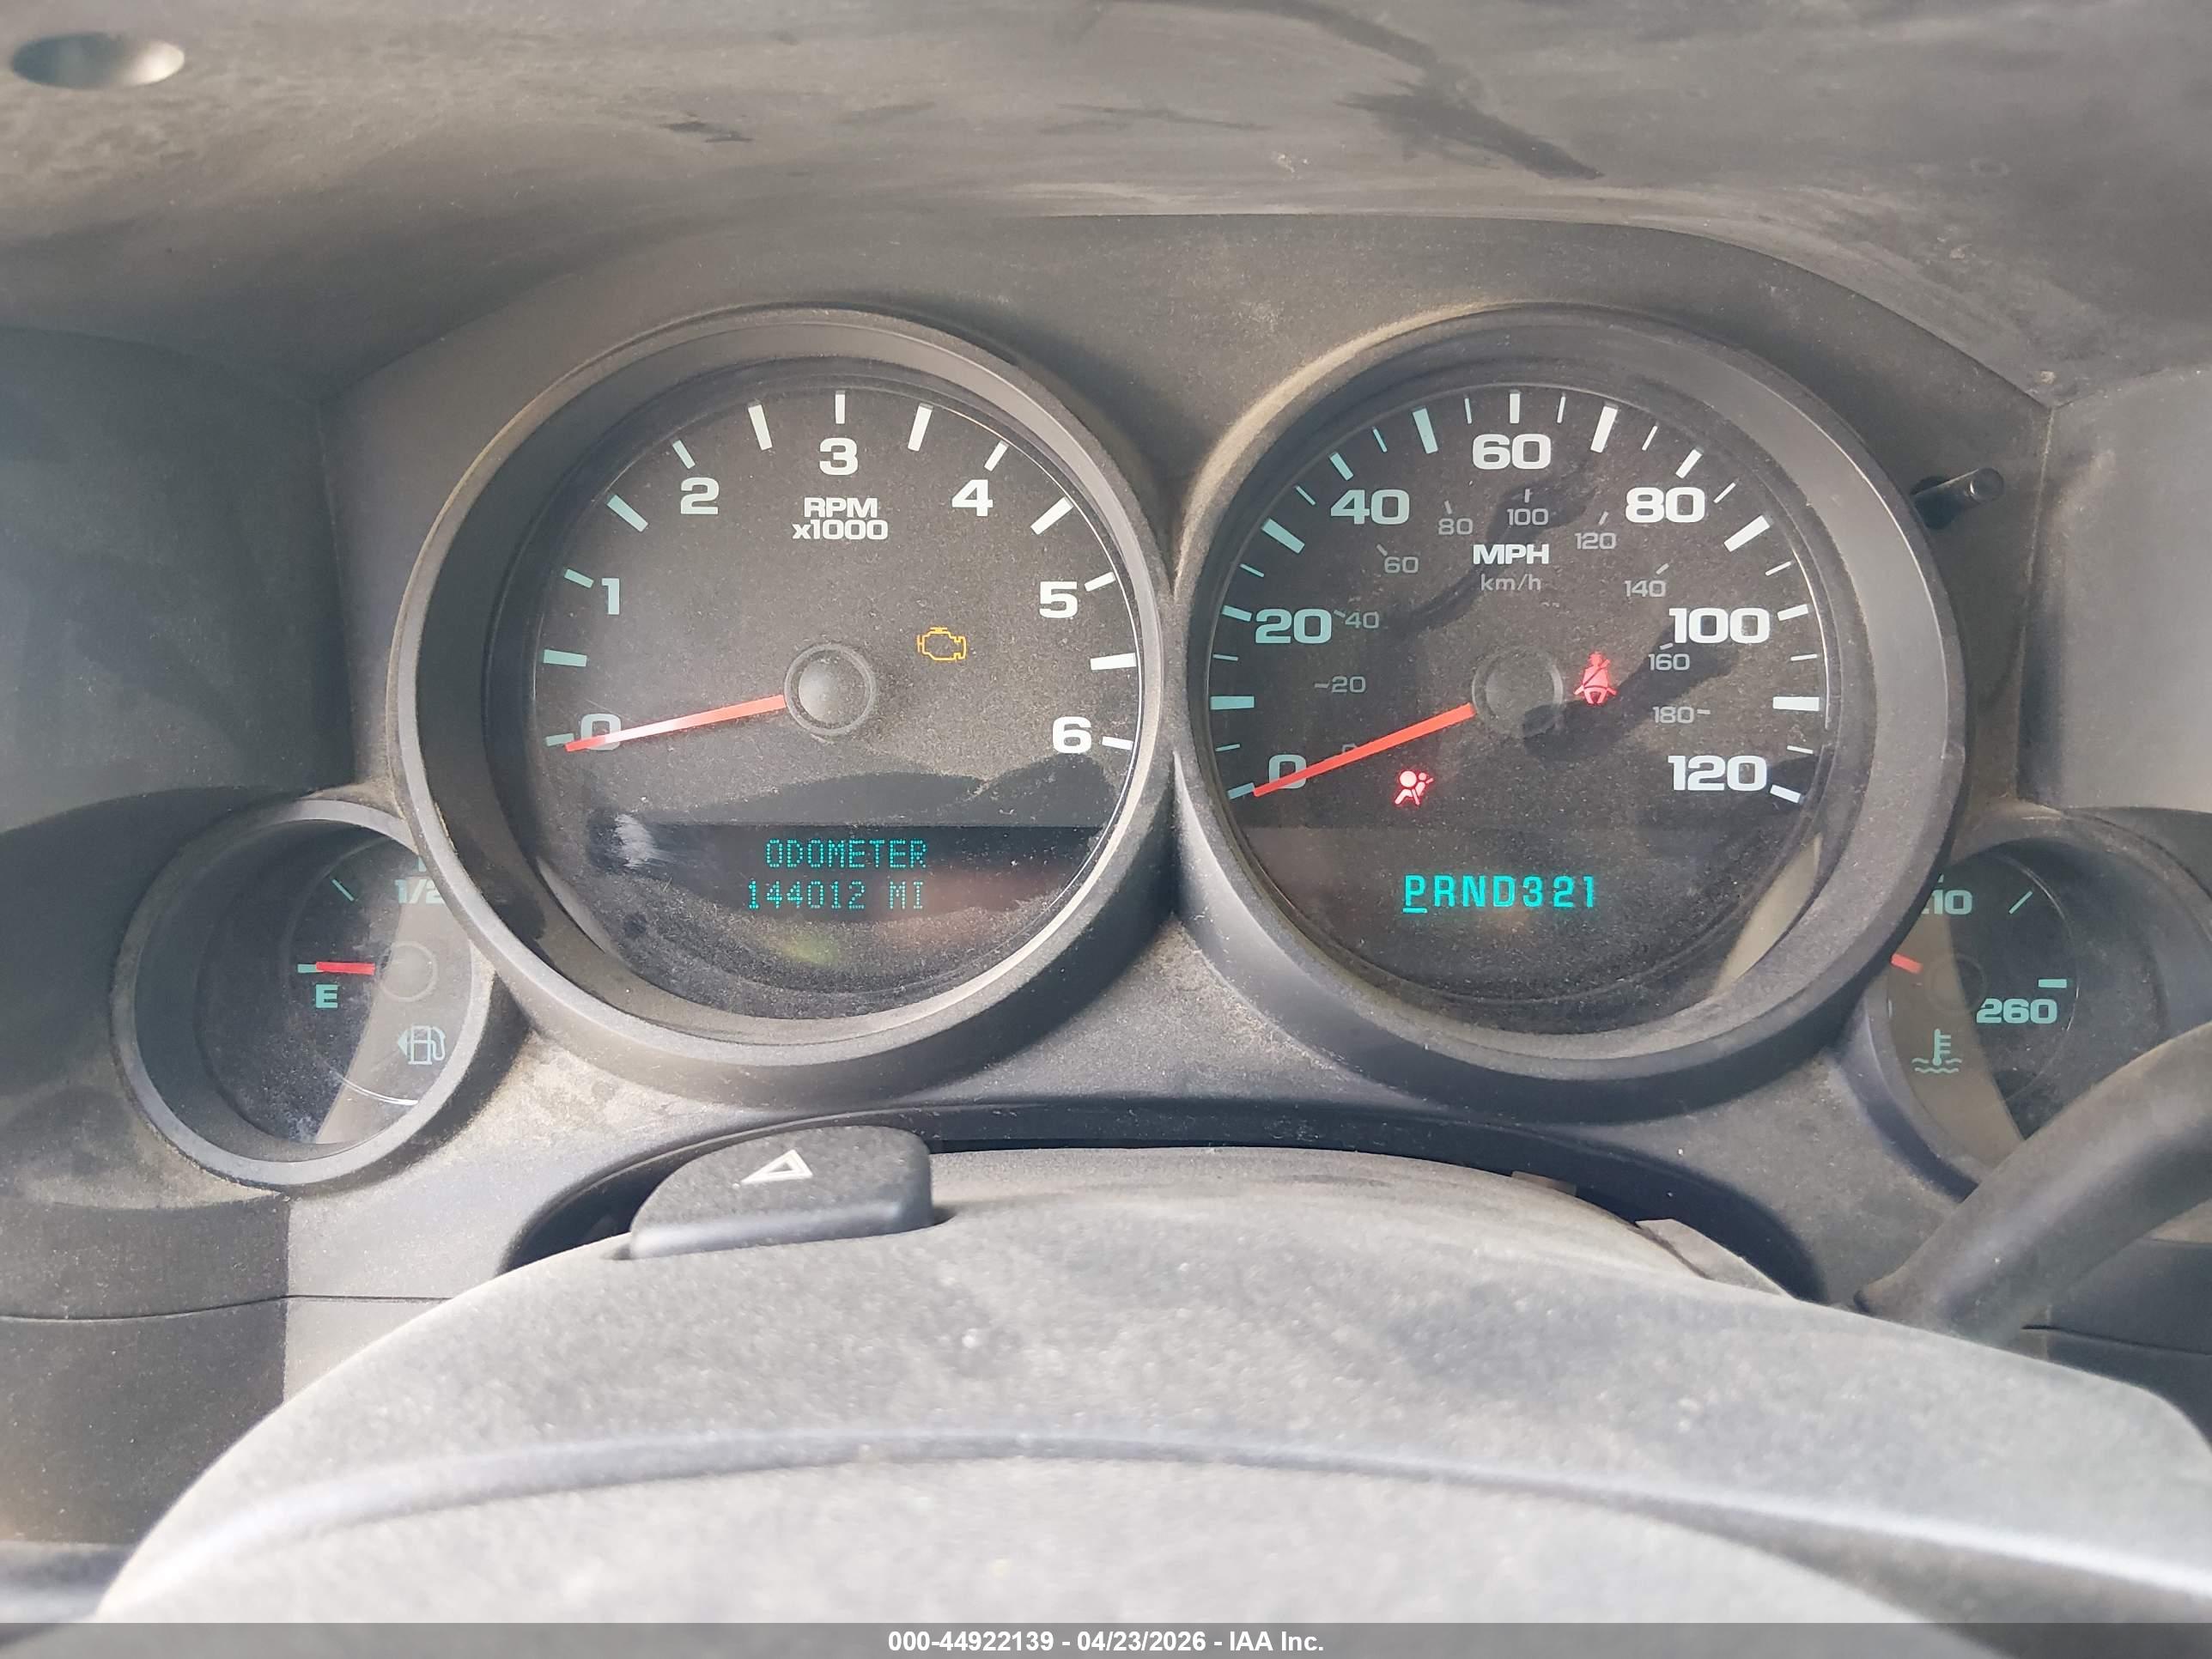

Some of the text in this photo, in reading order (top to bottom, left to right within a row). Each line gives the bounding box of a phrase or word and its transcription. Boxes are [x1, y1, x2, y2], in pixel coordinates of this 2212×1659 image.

[819, 439, 858, 475] 3
[1472, 434, 1551, 470] 60
[680, 478, 719, 515] 2
[804, 498, 878, 517] RPM
[951, 479, 994, 516] 4
[1330, 489, 1409, 525] 40
[1625, 488, 1705, 523] 80
[792, 520, 888, 540] x1000
[1437, 519, 1474, 536] 80
[1507, 509, 1548, 526] 100
[1473, 544, 1549, 564] MPH
[1575, 532, 1616, 550] 120
[1384, 556, 1419, 574] 60
[602, 578, 620, 615] 1
[1480, 574, 1542, 592] km/h
[1624, 580, 1666, 598] 140
[1039, 581, 1079, 618] 5
[1255, 609, 1332, 643] 20
[1345, 612, 1380, 629] 40
[1668, 607, 1770, 643] 100
[1649, 653, 1690, 671] 160
[1332, 676, 1366, 693] 20
[1653, 707, 1694, 723] 180
[580, 714, 622, 750] 0
[1052, 717, 1092, 754] 6
[1269, 754, 1307, 789] 0
[1668, 756, 1767, 791] 120
[766, 839, 927, 869] ODOMETER
[747, 880, 924, 910] 144012 MI
[1922, 890, 1972, 915] 10
[315, 984, 338, 1008] E
[1976, 999, 2057, 1024] 260
